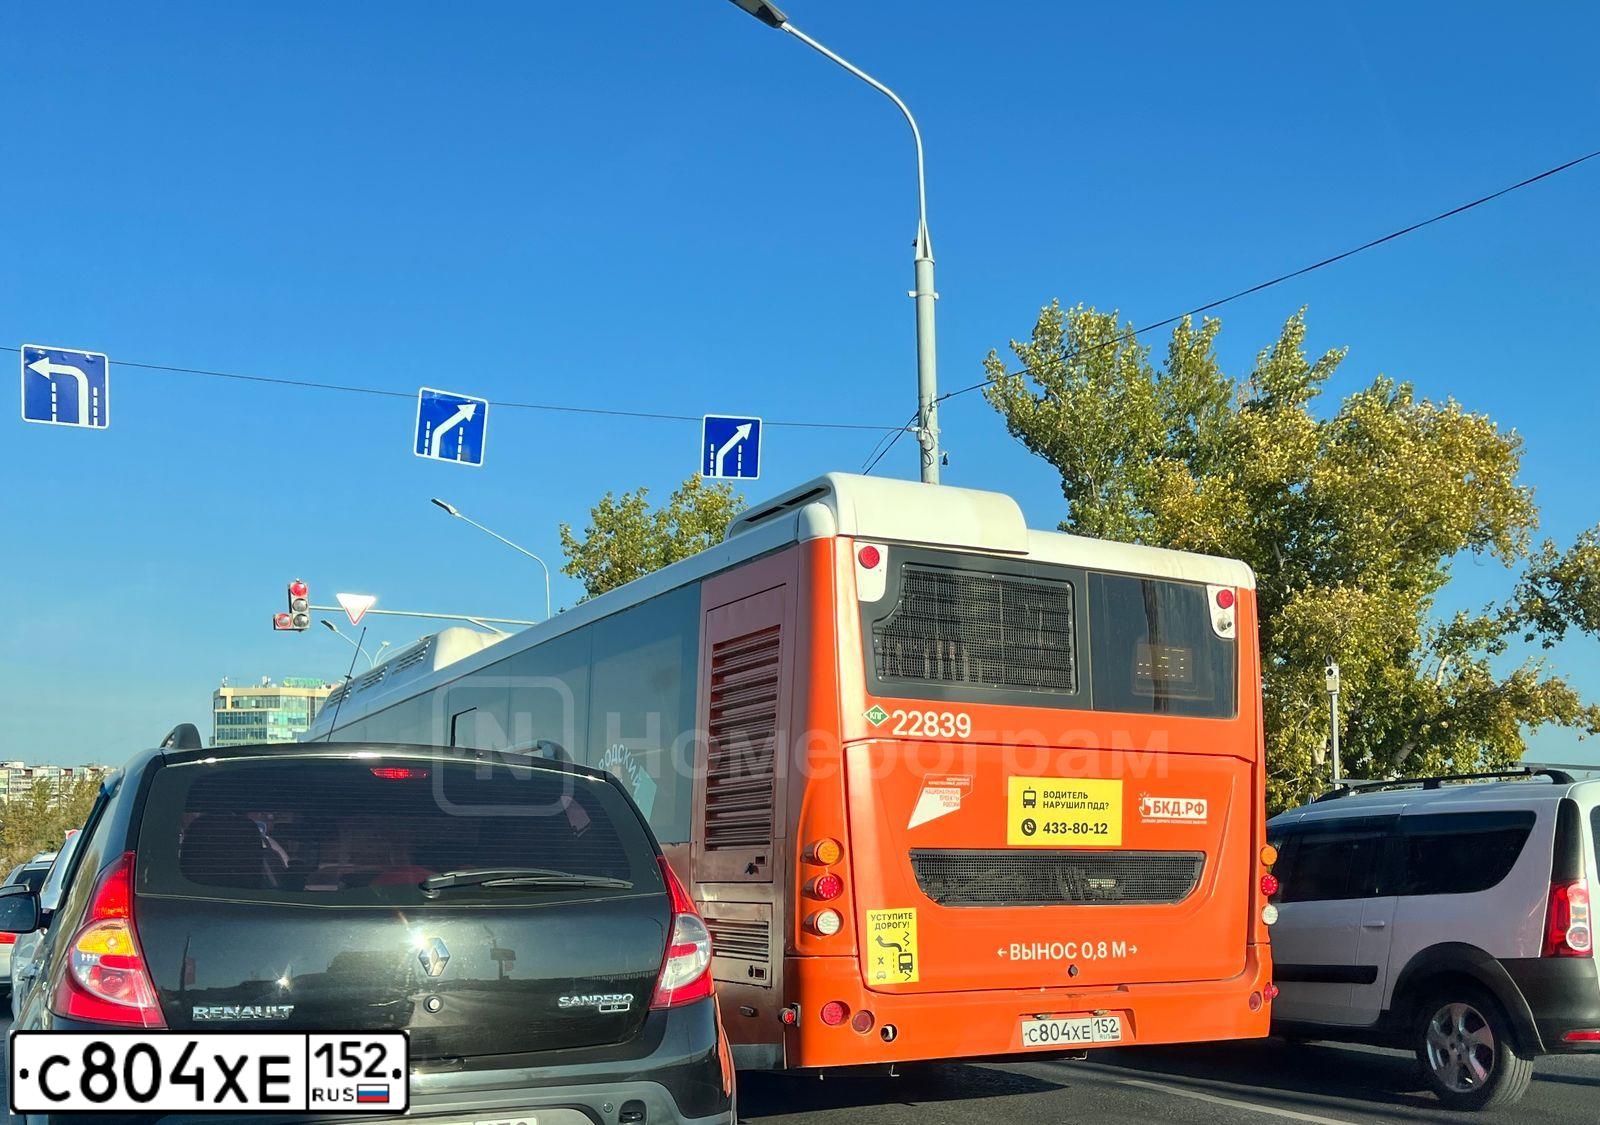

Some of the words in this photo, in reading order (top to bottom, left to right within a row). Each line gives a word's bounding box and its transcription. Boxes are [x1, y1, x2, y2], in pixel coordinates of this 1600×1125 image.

[868, 711, 884, 720] КПГ
[891, 709, 972, 739] 22839
[1043, 791, 1089, 799] ВОДИТЕЛЬ
[1042, 801, 1086, 810] НАРУШИЛ
[1087, 802, 1109, 811] ПДД?
[1153, 801, 1205, 816] БКД.РФ
[1042, 822, 1108, 835] 433-80-12
[871, 912, 913, 921] УСТУПИТЕ
[875, 921, 910, 931] ДОРОГУ!
[1010, 942, 1077, 961] ВЫНОС
[1081, 941, 1108, 960] 0,8
[1112, 941, 1127, 958] М
[558, 993, 634, 1008] SANDERO
[192, 1005, 295, 1020] RENAULT
[1028, 1022, 1091, 1042] С804ХЕ
[1094, 1018, 1118, 1034] 152
